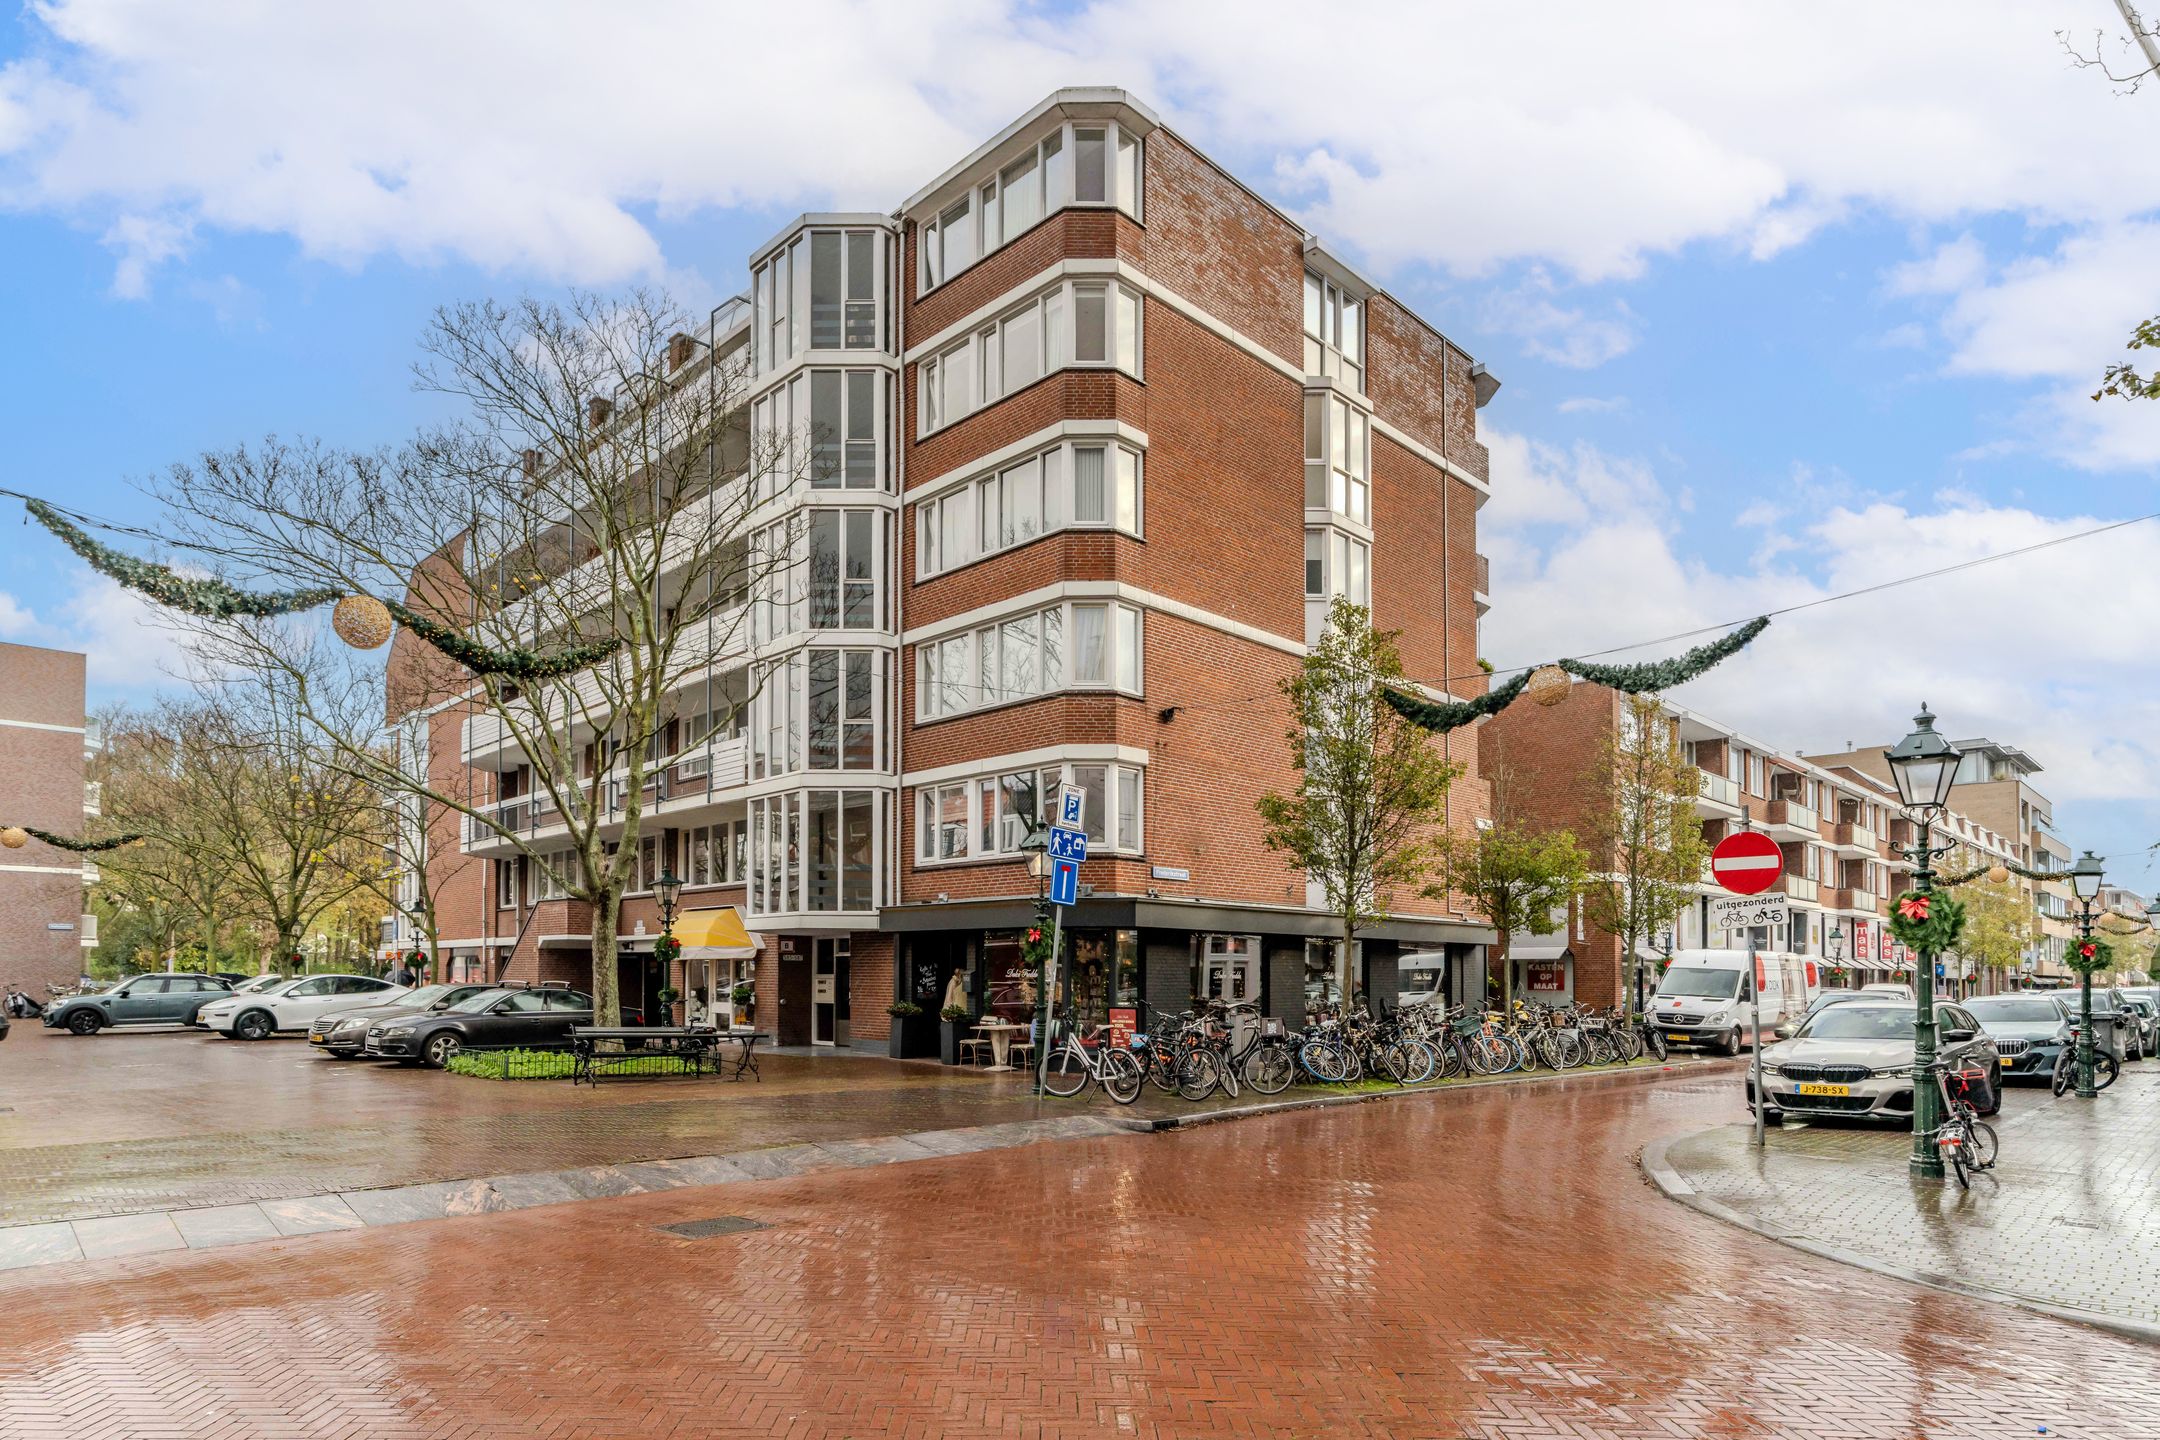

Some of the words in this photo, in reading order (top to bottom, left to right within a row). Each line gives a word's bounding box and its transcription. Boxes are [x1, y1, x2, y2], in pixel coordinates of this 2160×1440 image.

[1068, 800, 1077, 812] P
[1716, 896, 1785, 910] uitgezonderd
[1804, 1085, 1845, 1094] J-738-SX
